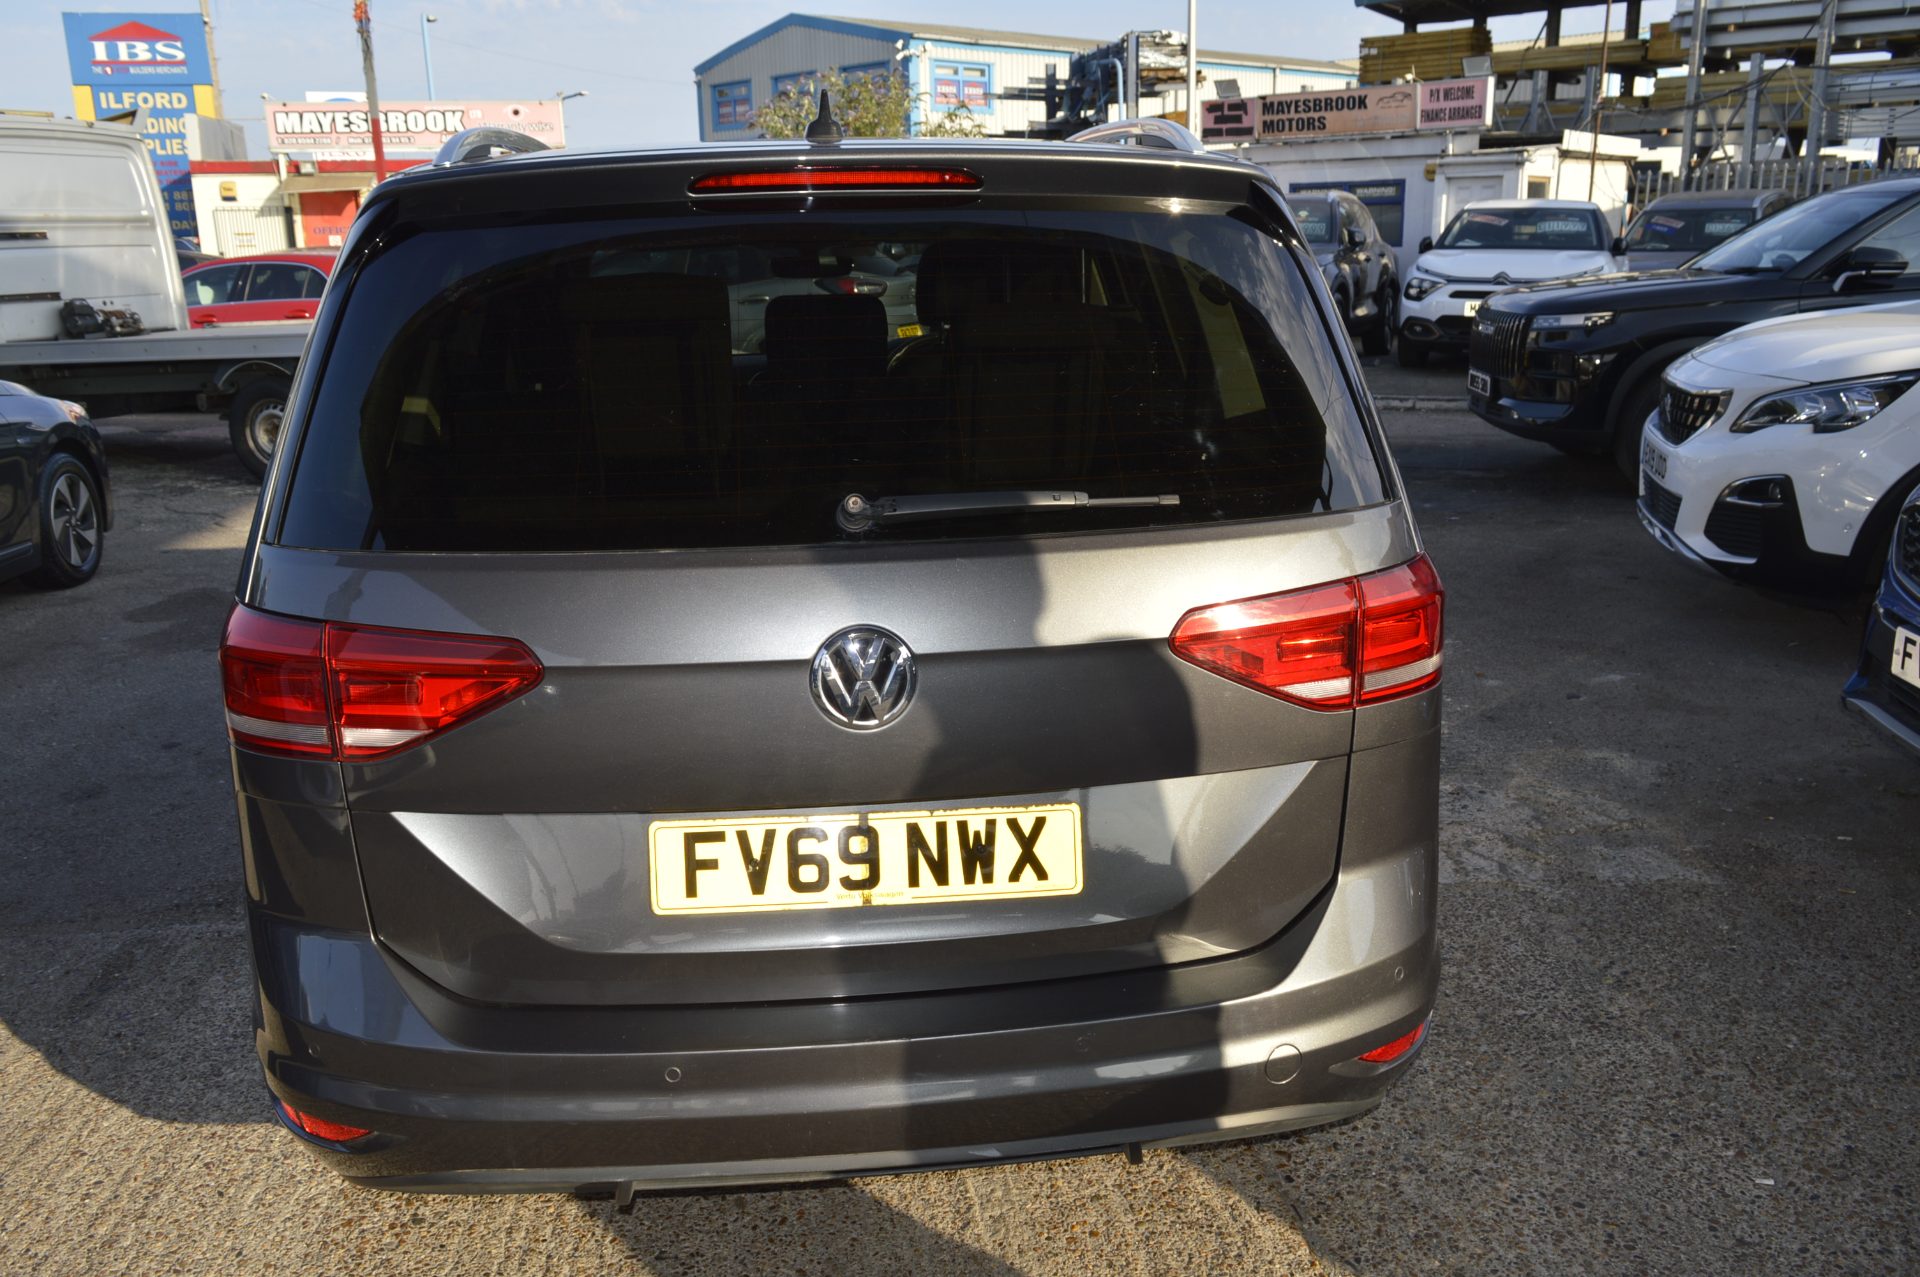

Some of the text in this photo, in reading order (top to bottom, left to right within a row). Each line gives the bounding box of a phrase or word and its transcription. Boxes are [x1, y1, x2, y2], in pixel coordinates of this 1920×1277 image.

[90, 40, 186, 61] IBS
[99, 92, 187, 109] ILFORD
[1429, 85, 1475, 102] P/X WELCOME
[1262, 94, 1368, 116] MAYESBROOK
[1420, 104, 1482, 122] FINANCE ARRANGED
[273, 110, 465, 134] MAYESBROOK
[1262, 116, 1327, 134] MOTORS
[683, 816, 1049, 899] FV69 NWX
